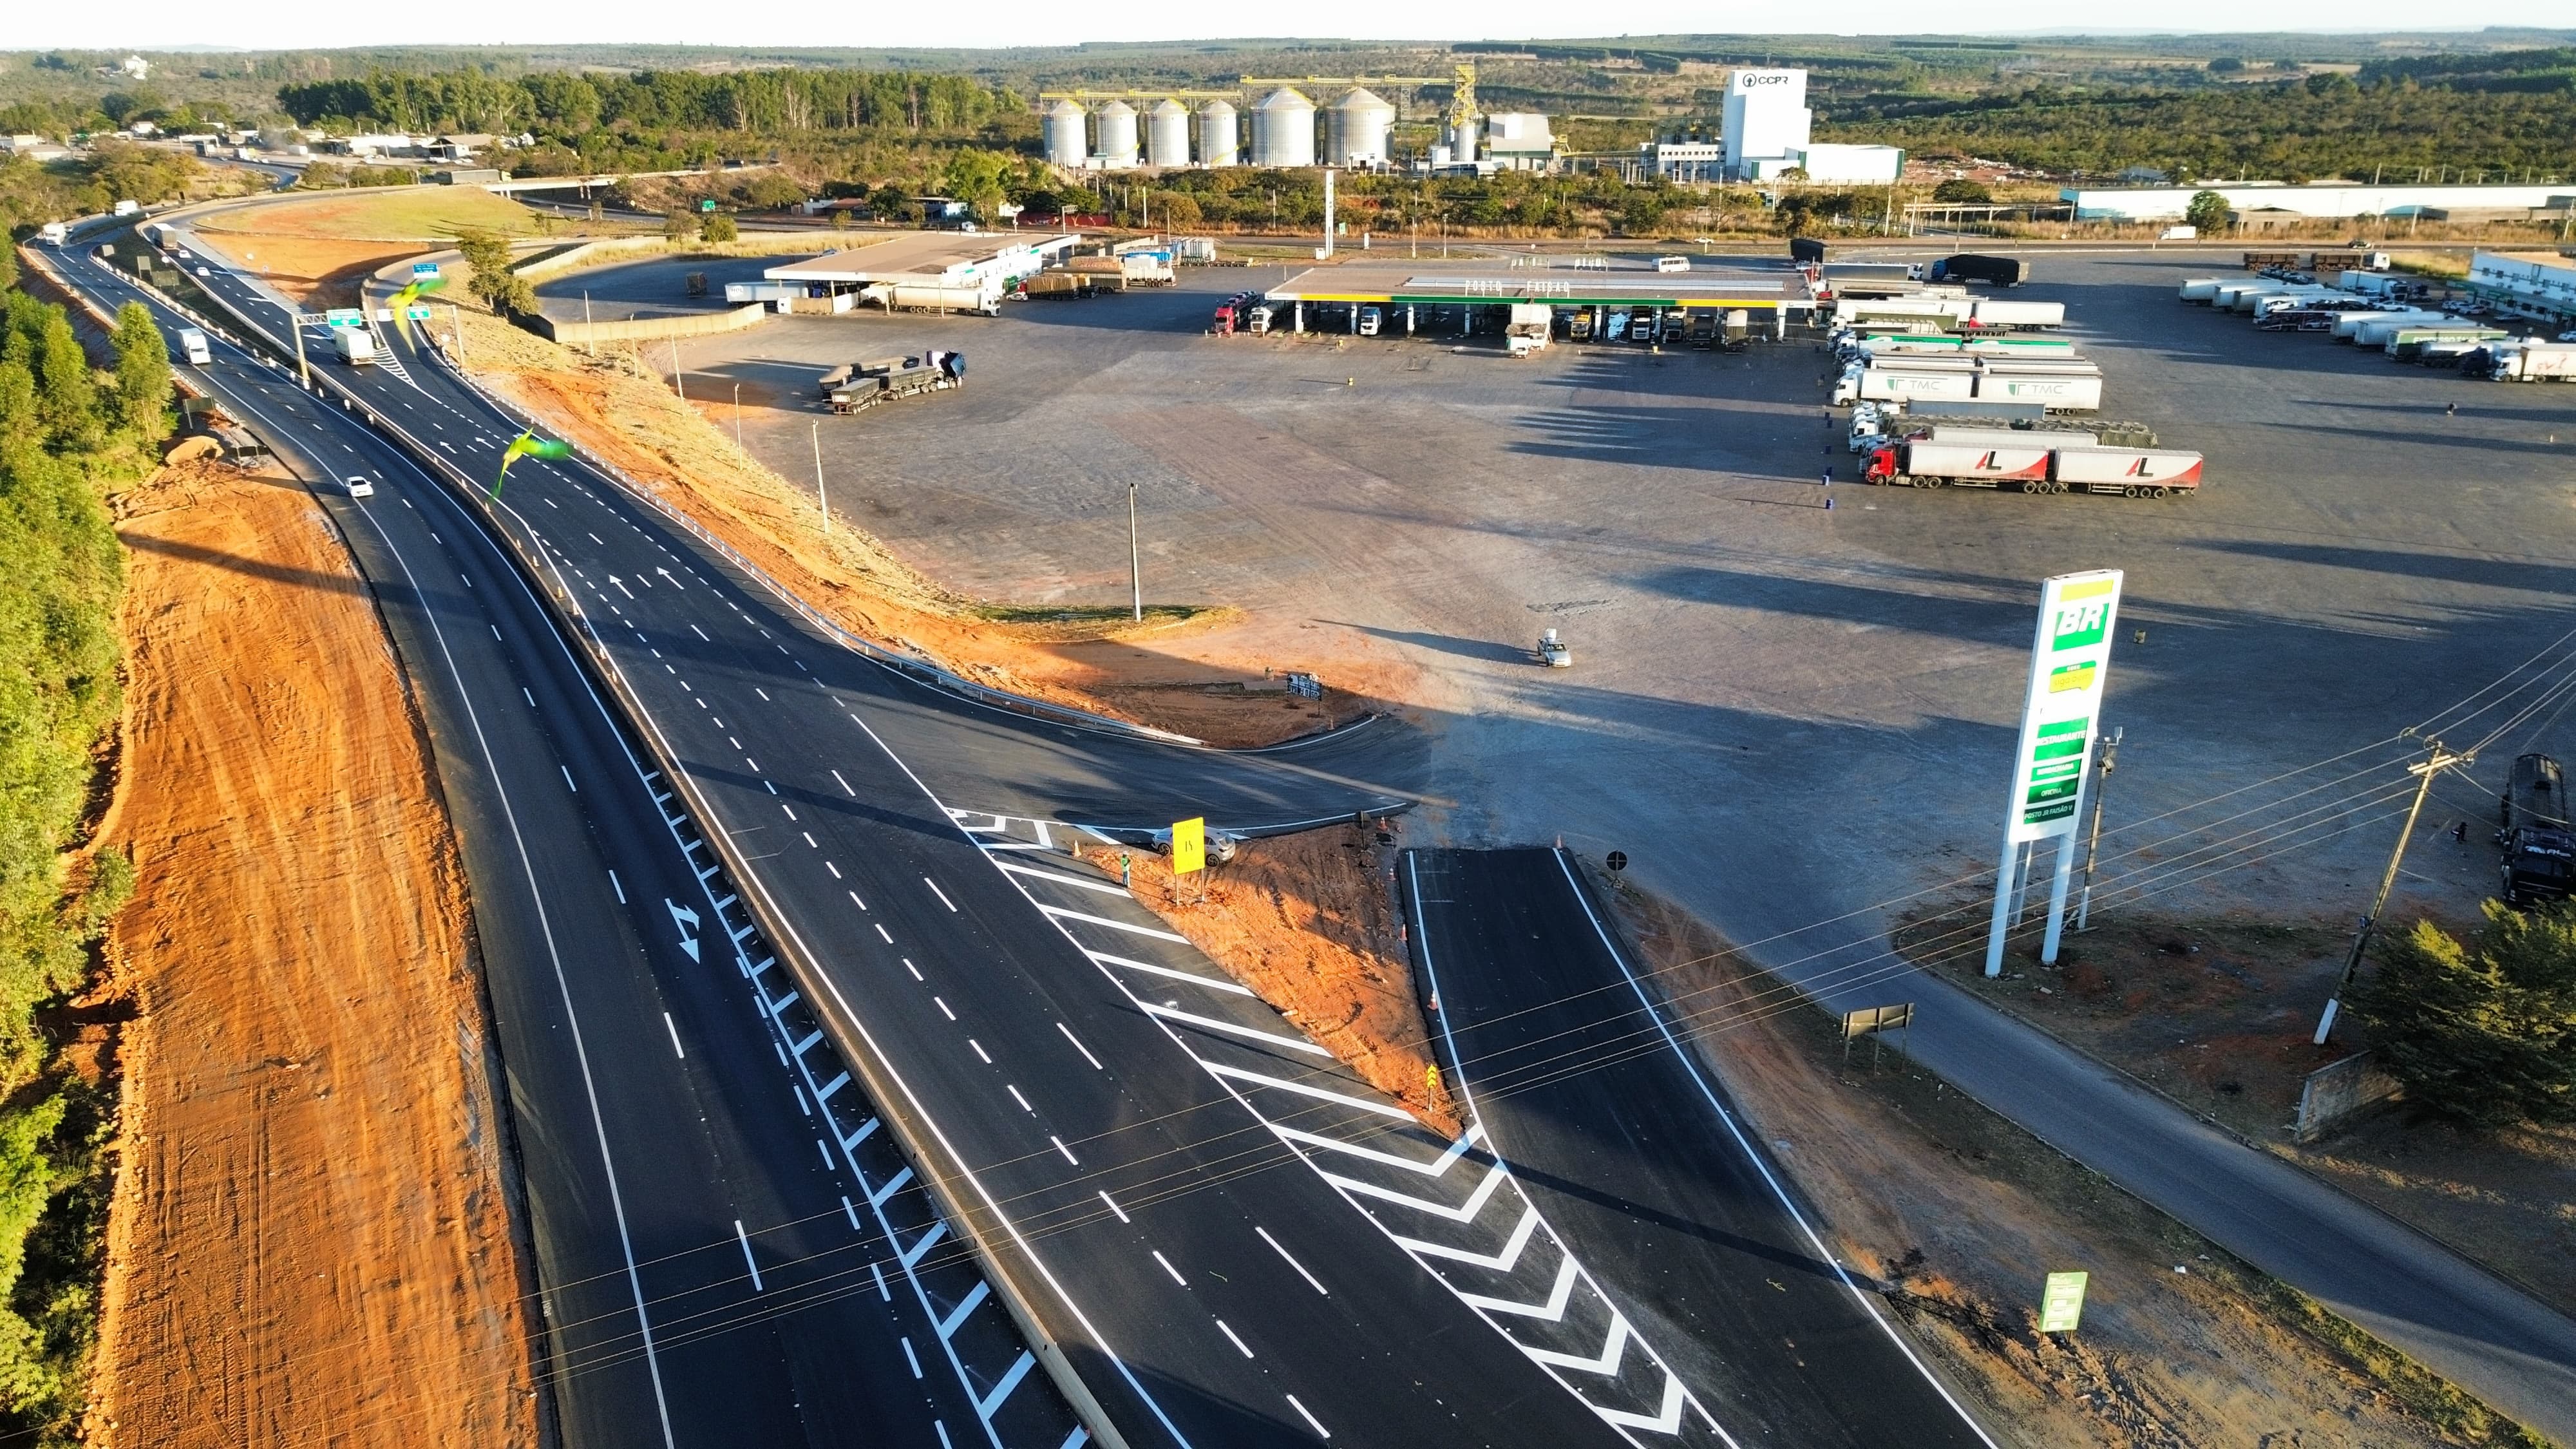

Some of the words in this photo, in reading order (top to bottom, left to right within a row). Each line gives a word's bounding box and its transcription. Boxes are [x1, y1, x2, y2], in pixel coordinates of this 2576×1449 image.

[1758, 76, 1788, 85] CCPR
[1465, 279, 1502, 292] POSTO
[1909, 380, 1941, 390] TMC
[2031, 384, 2064, 394] TMC
[1975, 450, 2002, 471] AL
[2125, 457, 2154, 477] AL
[2056, 603, 2105, 637] BR
[2023, 811, 2042, 820] POSTO
